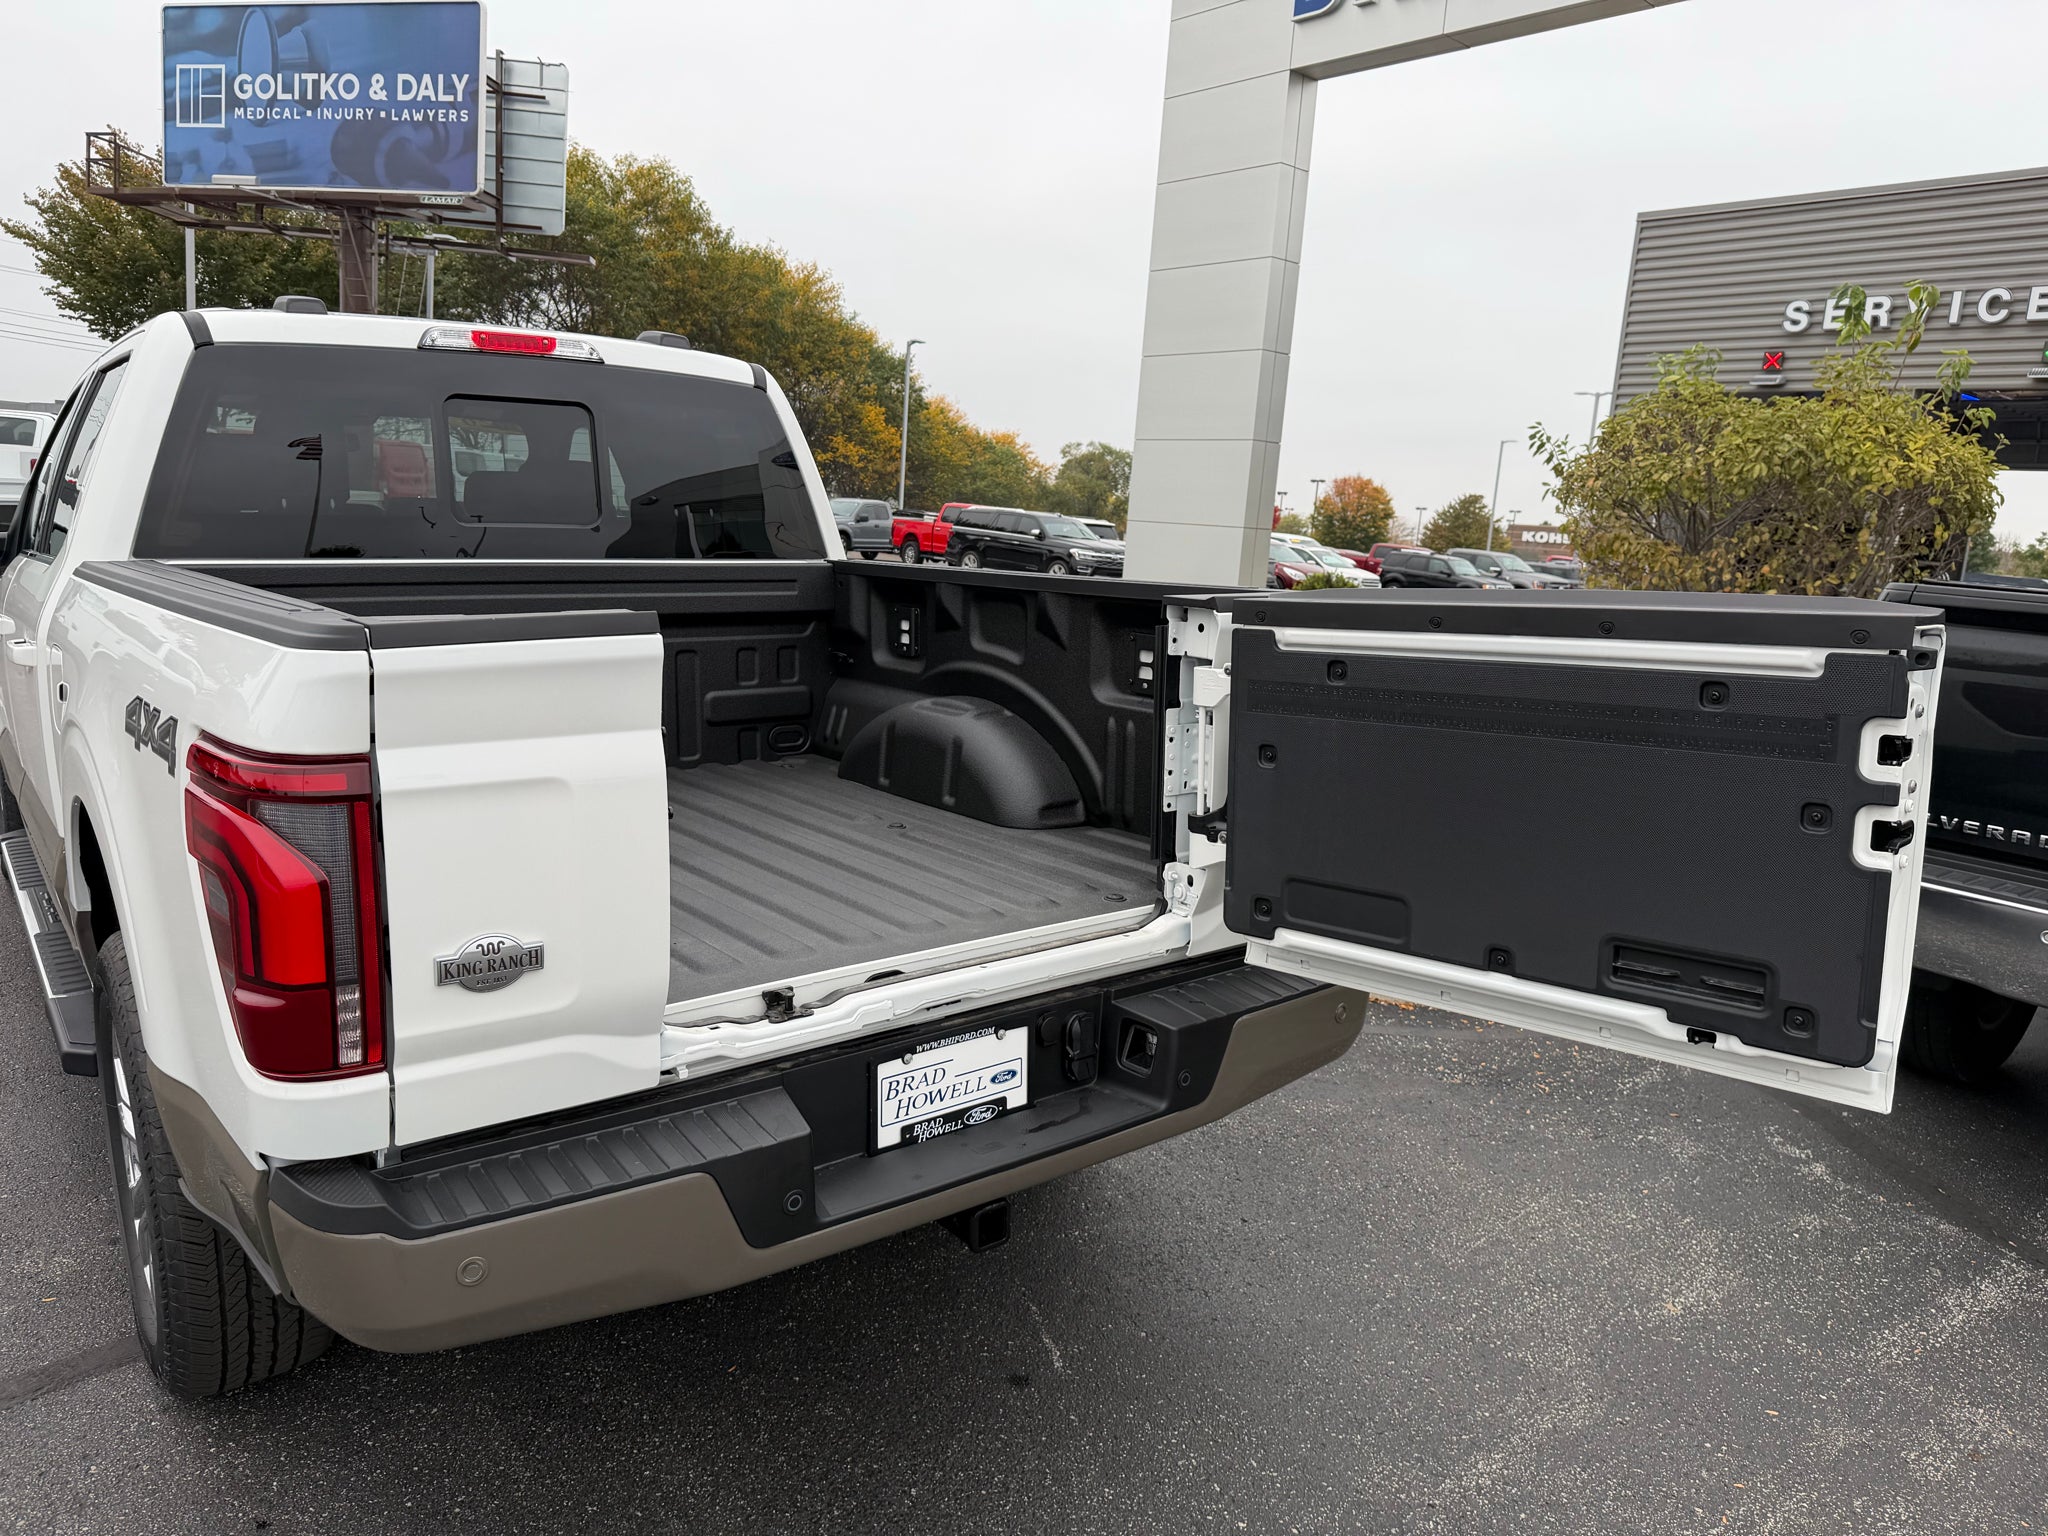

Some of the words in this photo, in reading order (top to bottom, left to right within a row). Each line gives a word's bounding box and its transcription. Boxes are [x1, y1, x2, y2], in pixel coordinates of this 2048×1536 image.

[233, 73, 360, 100] GOLITKO
[369, 73, 388, 101] &
[397, 74, 470, 102] DALY
[234, 107, 300, 120] MEDICAL
[317, 108, 374, 121] INJURY
[391, 109, 469, 122] LAWYERS
[424, 196, 459, 204] LAMAR
[443, 961, 482, 980] KING
[487, 949, 539, 973] RANCH
[916, 1027, 995, 1053] WWW.BHIFORD.COM
[885, 1067, 946, 1101] BRAD
[894, 1076, 987, 1120] HOWELL
[913, 1118, 944, 1136] BRAD
[918, 1120, 964, 1143] HOWELL
[969, 1107, 993, 1122] Ford
